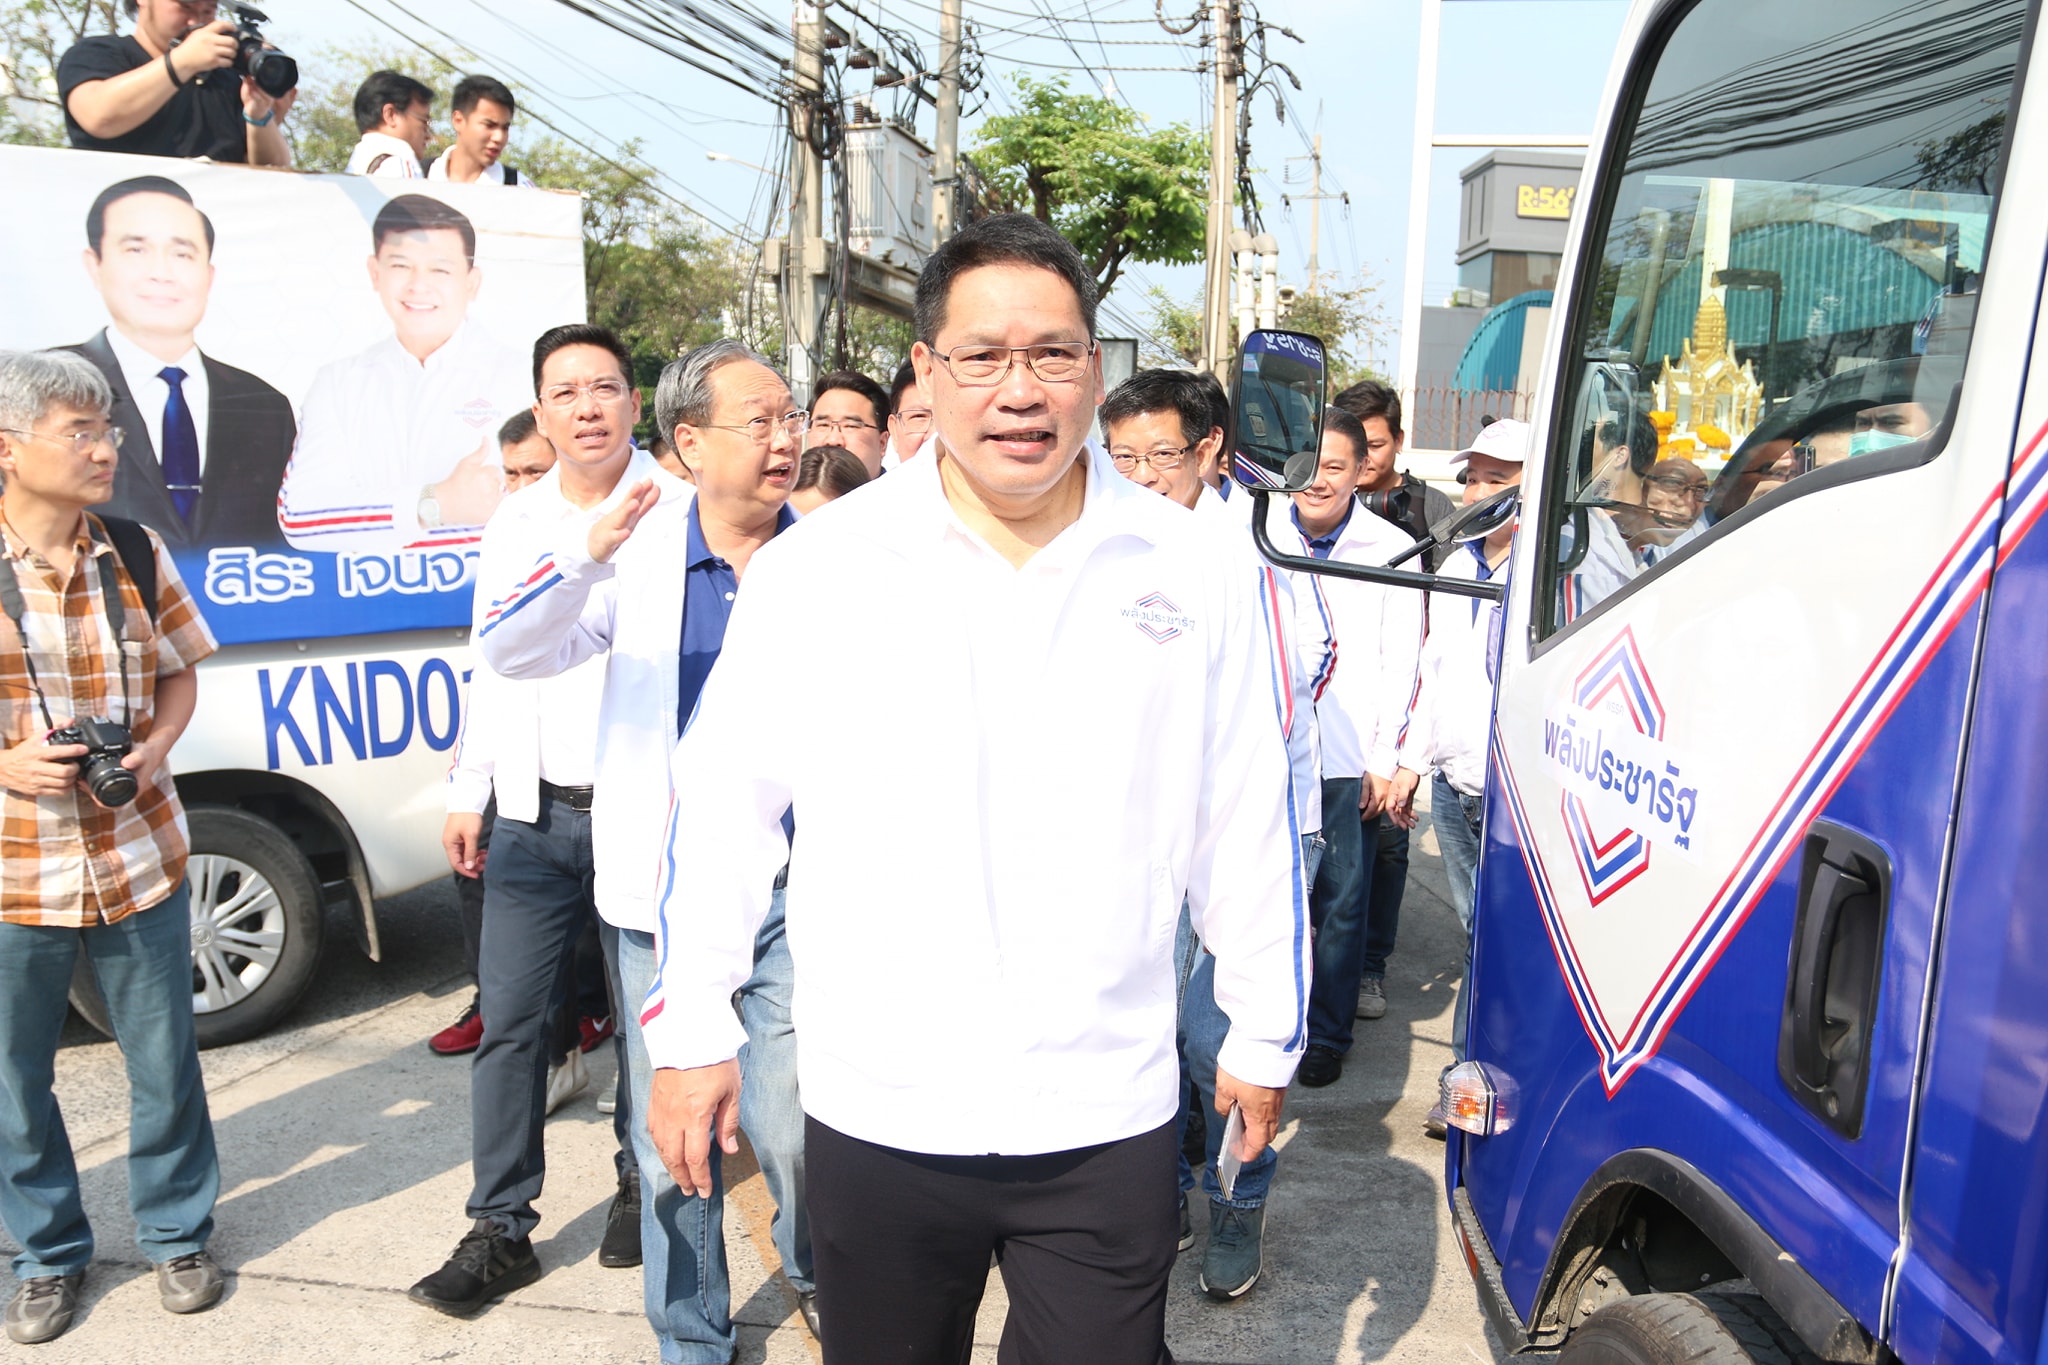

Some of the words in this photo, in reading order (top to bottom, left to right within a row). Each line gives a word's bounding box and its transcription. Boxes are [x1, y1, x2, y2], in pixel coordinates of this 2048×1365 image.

[206, 549, 314, 603] สิระ
[1120, 607, 1195, 631] พลังประชารัฐ
[257, 657, 475, 770] KND0
[1545, 714, 1698, 850] พลังประชารัฐ
